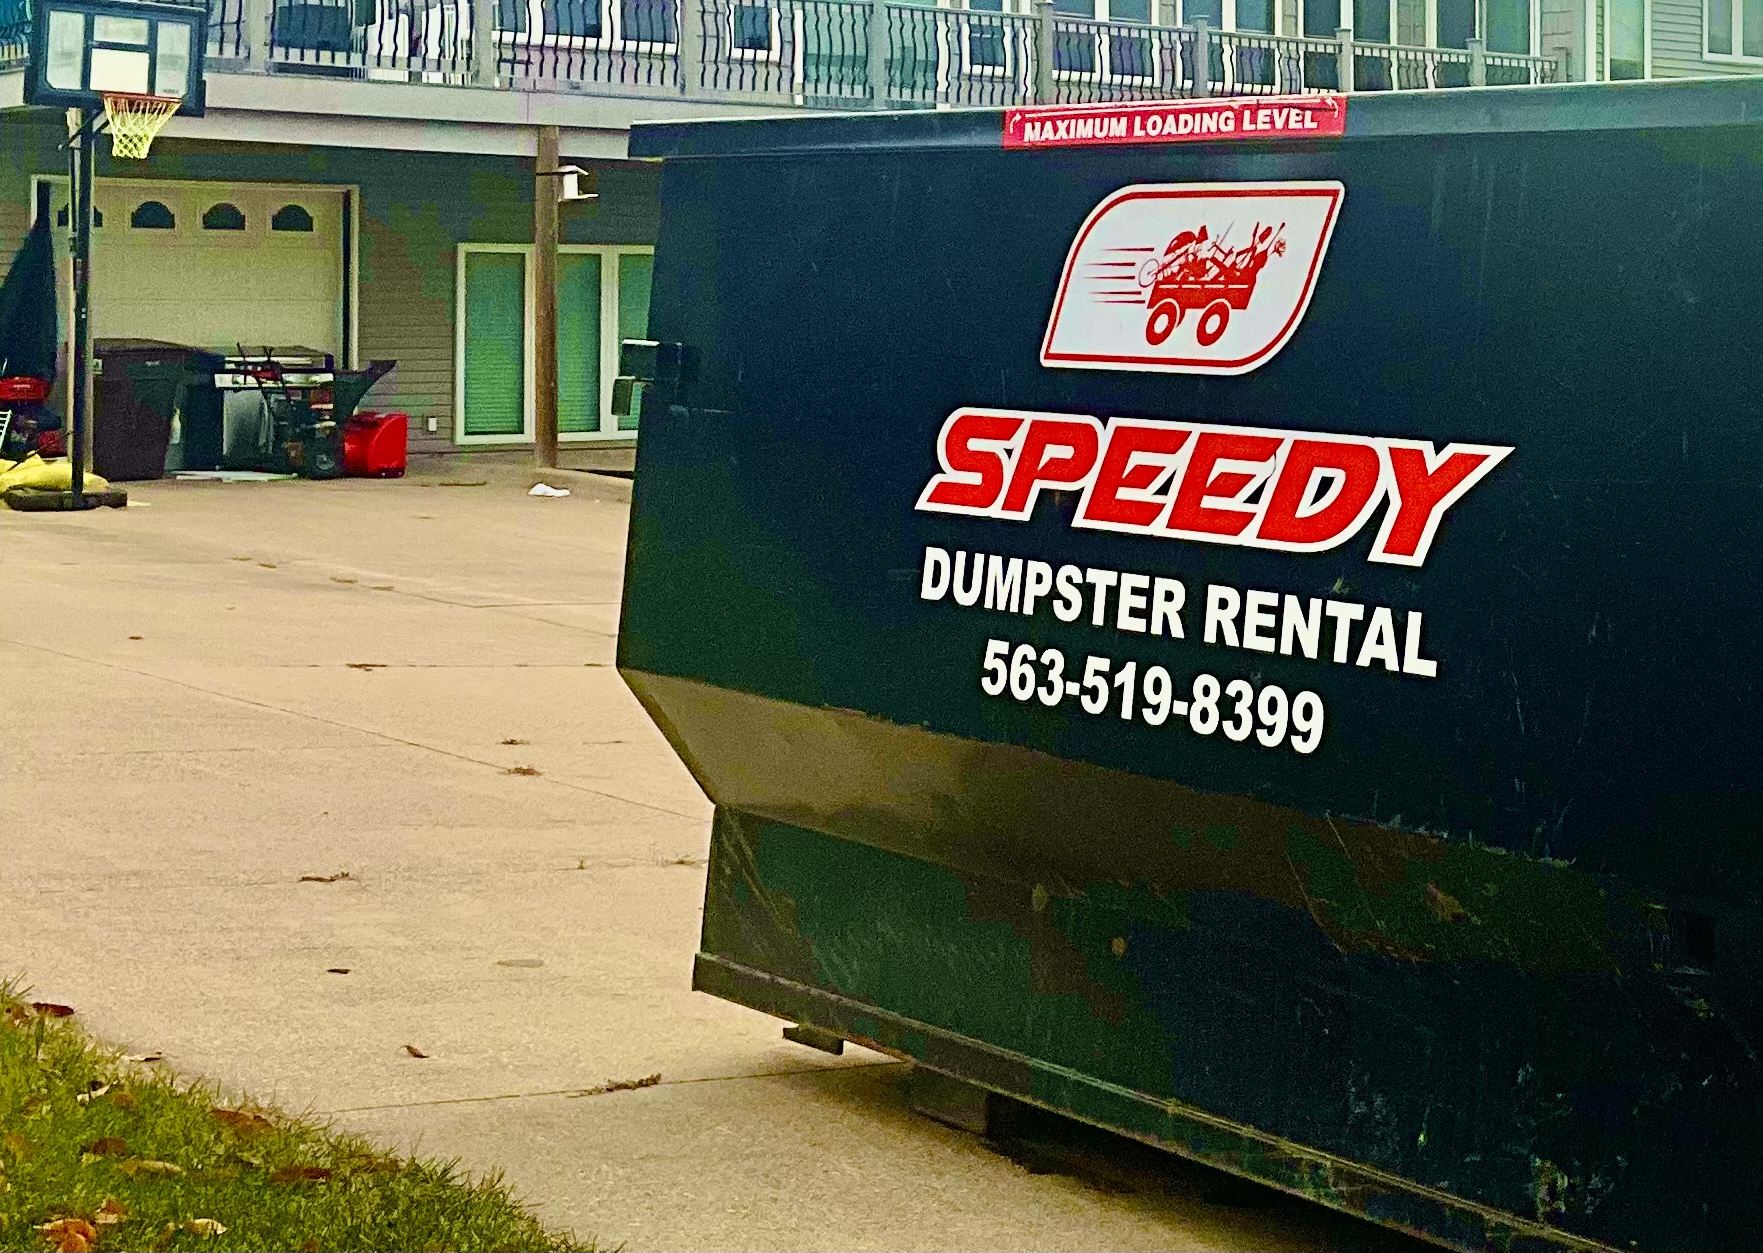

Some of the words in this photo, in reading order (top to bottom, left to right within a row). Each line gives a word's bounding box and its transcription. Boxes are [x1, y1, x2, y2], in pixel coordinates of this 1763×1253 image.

[1023, 118, 1126, 142] MAXIMUM
[1133, 110, 1235, 137] LOADING
[1242, 107, 1319, 131] LEVEL
[915, 406, 1515, 567] SPEEDY
[920, 546, 1186, 639] DUMPSTER
[1204, 584, 1438, 677] RENTAL
[981, 639, 1325, 754] 563-519-8399
